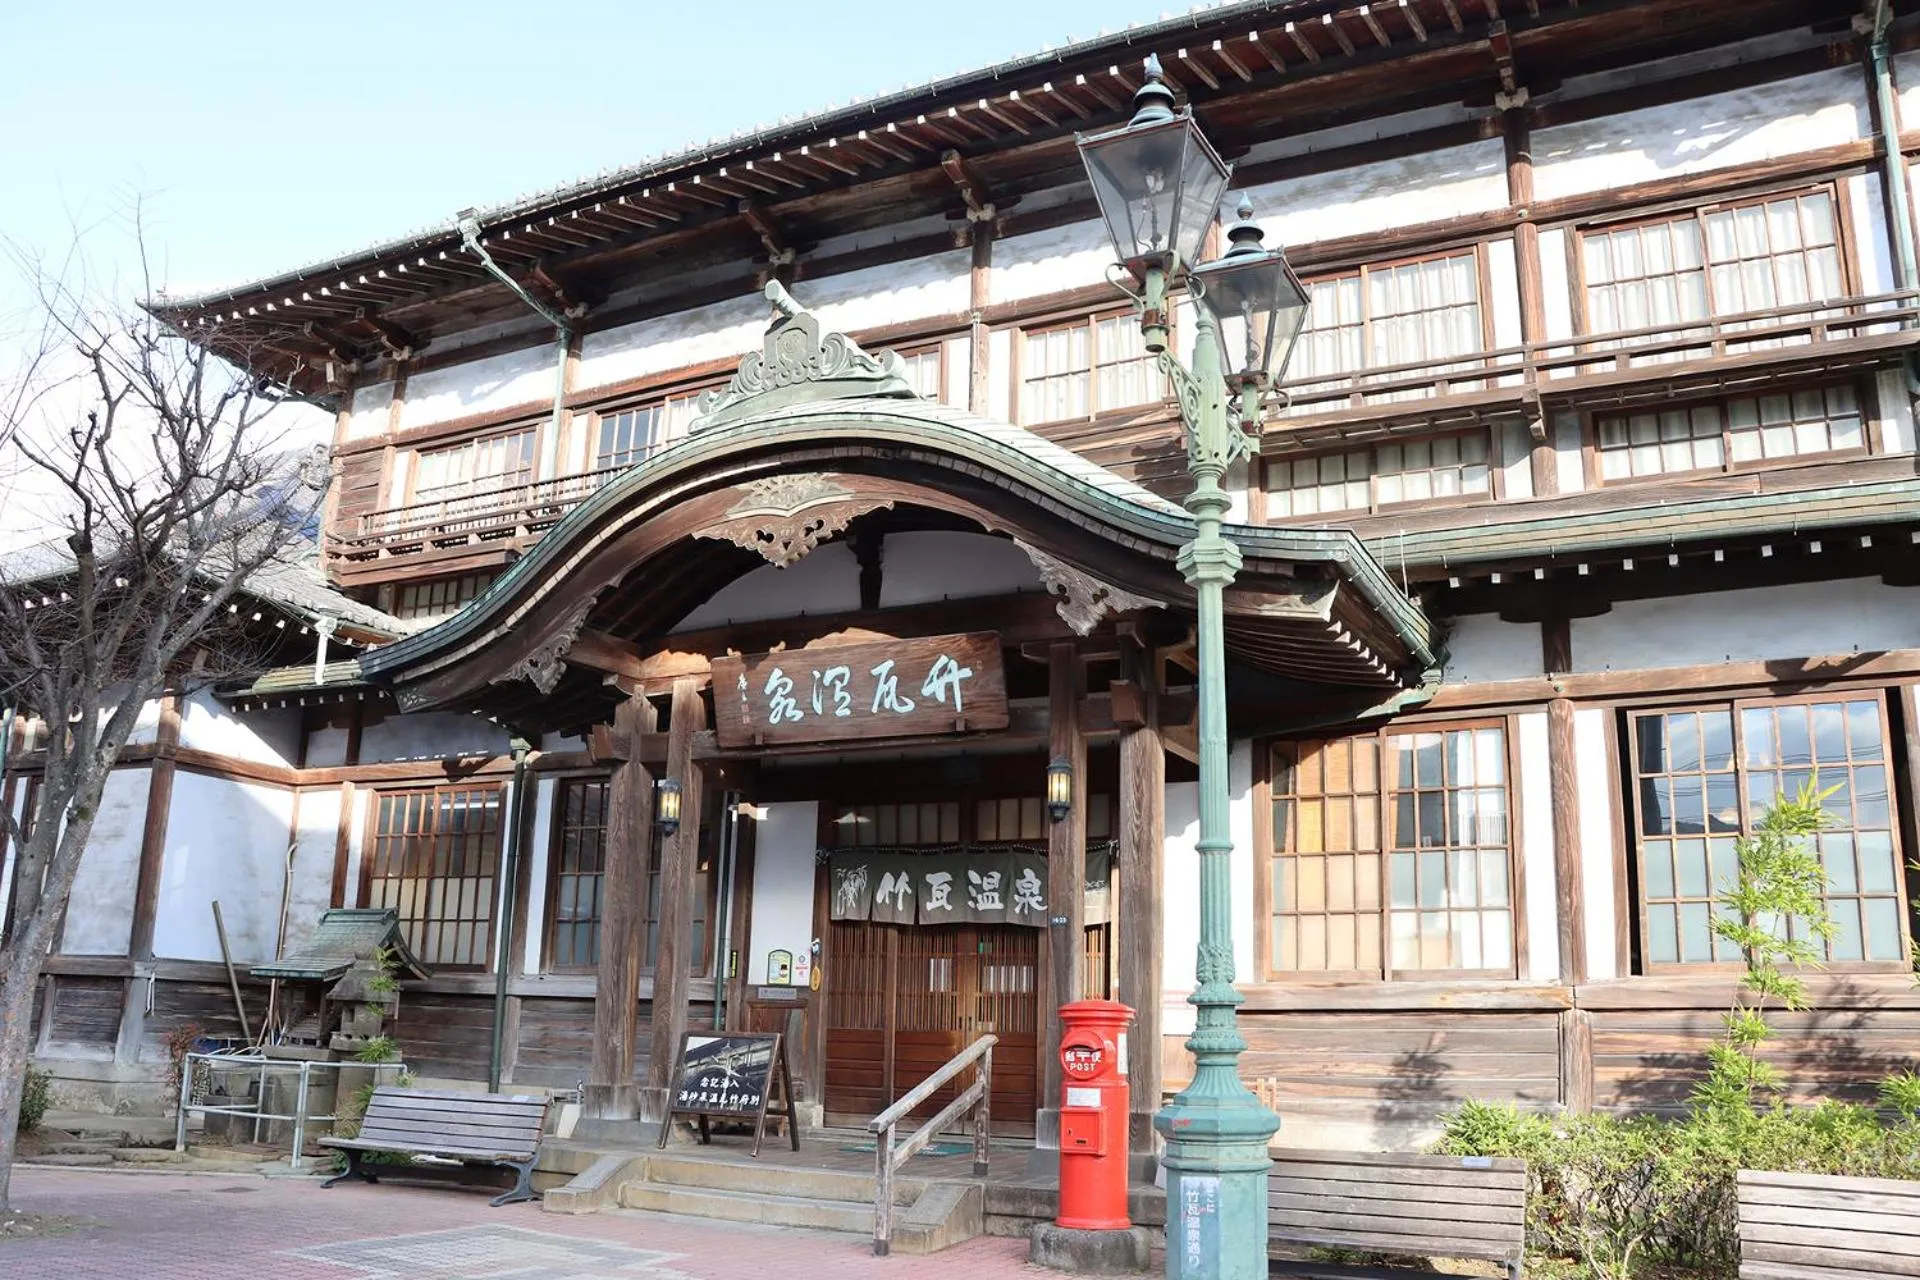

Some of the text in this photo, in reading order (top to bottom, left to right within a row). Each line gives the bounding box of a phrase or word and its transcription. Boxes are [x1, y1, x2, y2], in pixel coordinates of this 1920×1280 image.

[876, 867, 1048, 915] 竹瓦温泉
[1070, 1063, 1096, 1071] POST
